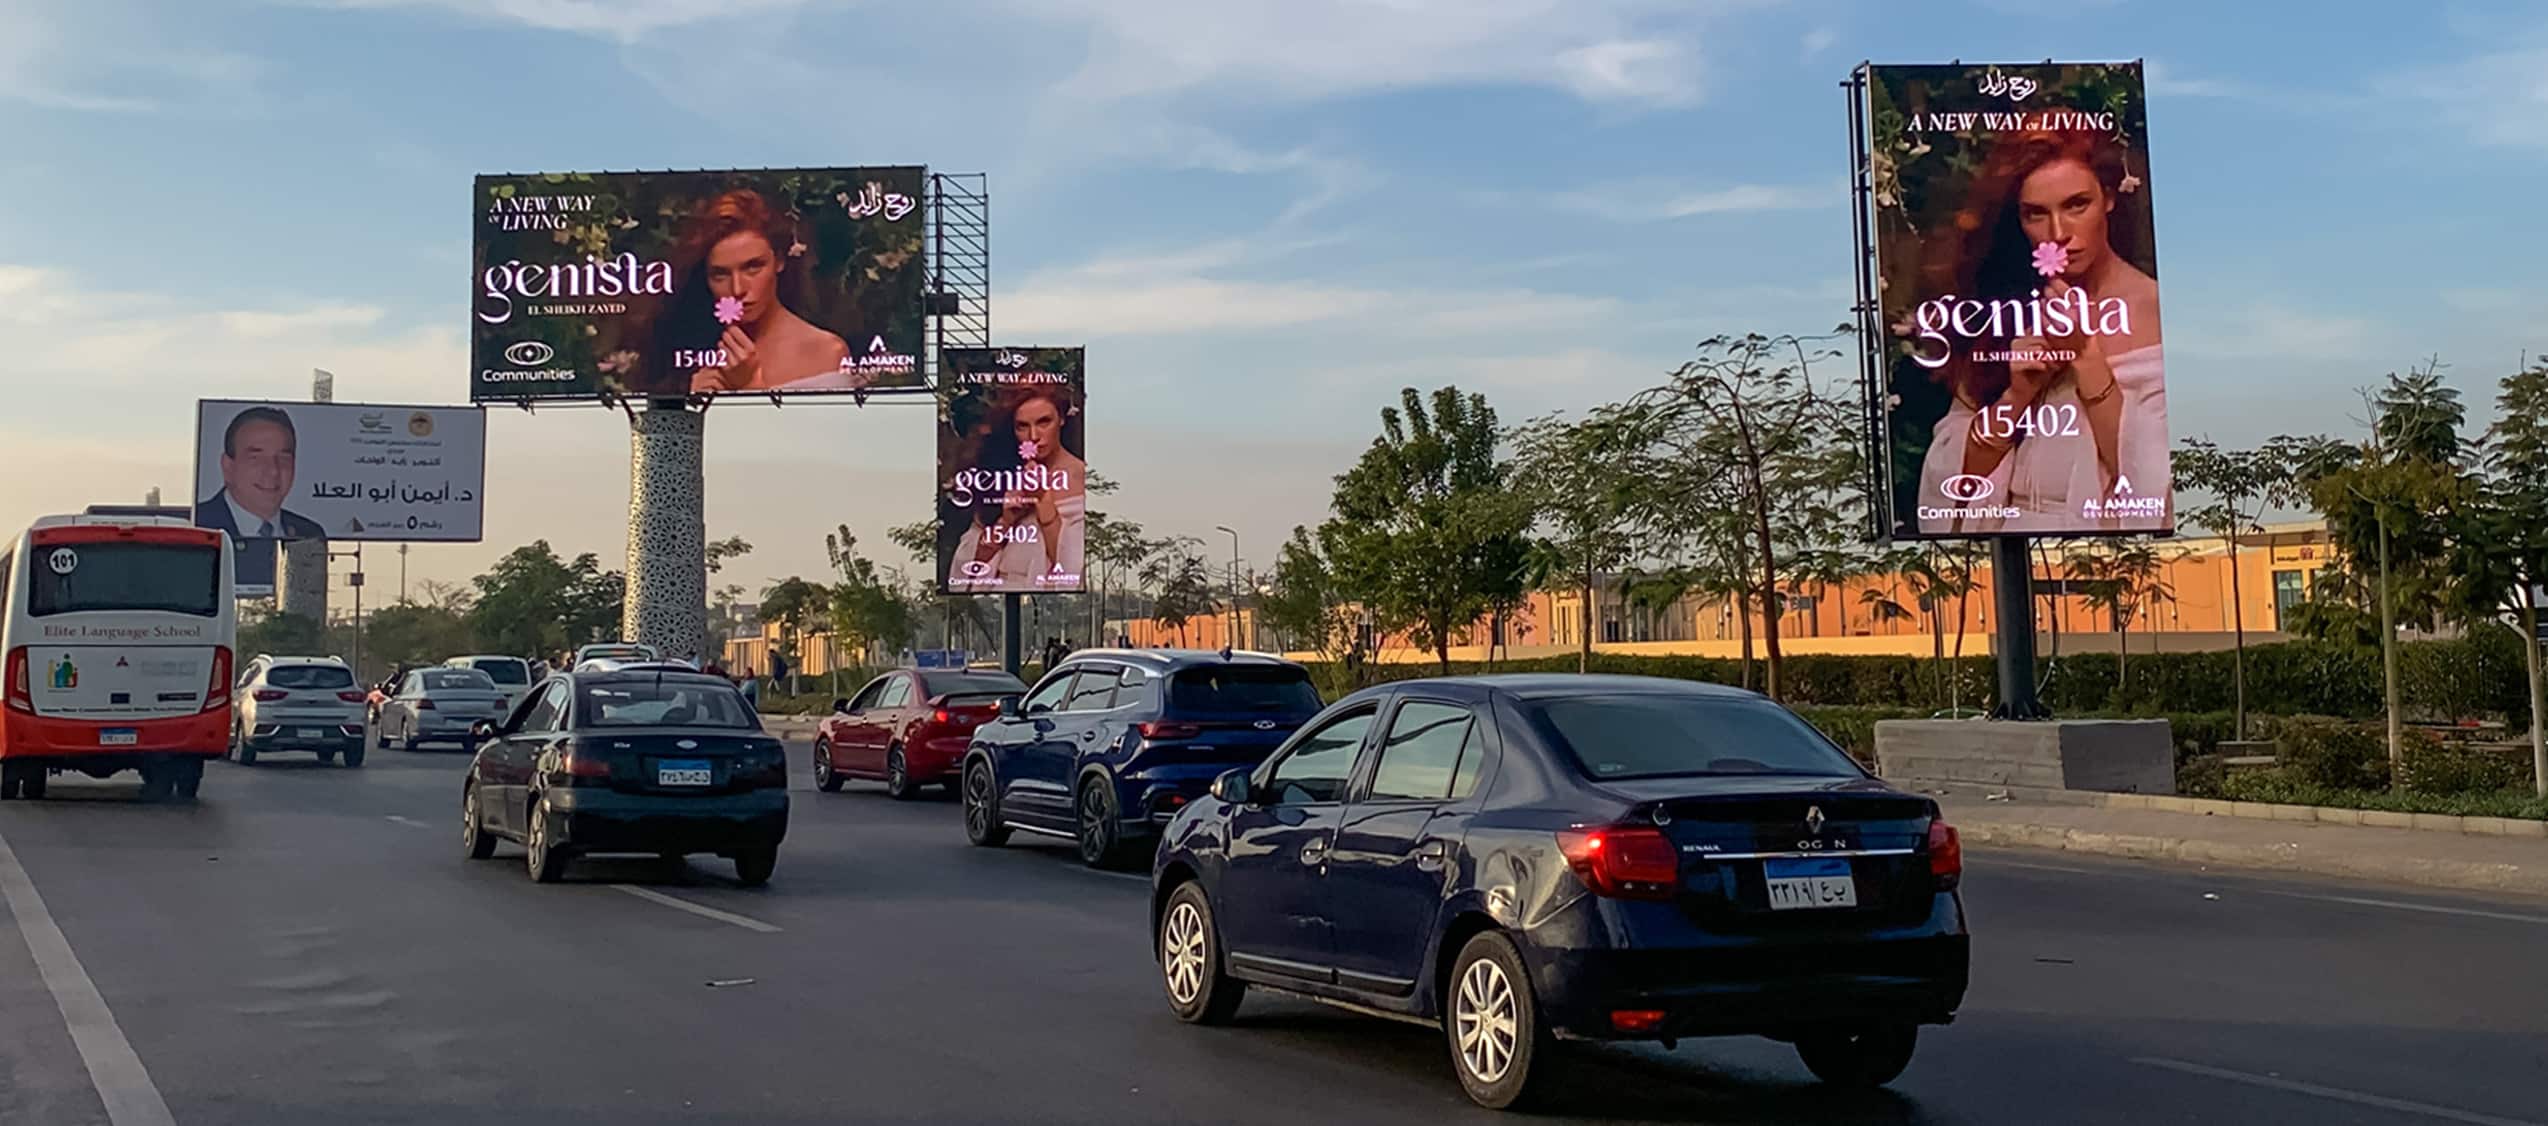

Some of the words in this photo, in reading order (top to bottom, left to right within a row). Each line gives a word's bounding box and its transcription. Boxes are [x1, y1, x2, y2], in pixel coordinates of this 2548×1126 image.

[2008, 76, 2037, 101] روح
[1907, 112, 1923, 132] A
[1928, 112, 1979, 132] NEW
[1982, 112, 2027, 132] WAY
[2040, 111, 2114, 132] LIVING
[489, 197, 503, 213] A
[507, 196, 553, 213] NEW
[556, 195, 596, 212] WAY
[884, 193, 917, 221] روح
[502, 213, 569, 231] LIVING
[478, 251, 674, 324] genista
[528, 305, 541, 316] EL
[588, 303, 627, 315] ZAYED
[1912, 285, 2132, 368] genista
[673, 349, 728, 368] 15402
[840, 355, 854, 366] AL
[859, 354, 915, 366] AMAKEN
[1973, 351, 1988, 362] EL
[1989, 351, 2033, 362] SHEIKH
[2035, 350, 2076, 362] ZAYED
[482, 368, 576, 382] Communities
[957, 373, 966, 384] A
[967, 372, 995, 384] NEW
[996, 373, 1021, 384] WAY
[1028, 372, 1069, 384] LIVING
[1979, 404, 2080, 438] 15402
[312, 481, 362, 499] العلا
[368, 480, 396, 503] أبو
[401, 481, 449, 504] أيمن
[951, 463, 1070, 507] genista
[1917, 504, 2021, 520] Communities
[2083, 498, 2101, 510] AL
[2104, 498, 2165, 510] AMAKEN
[2083, 510, 2166, 519] DEVELOPMENTS
[983, 525, 1039, 544] 15402
[52, 554, 75, 568] 101
[44, 625, 76, 637] Elite
[81, 625, 149, 640] Language
[153, 625, 202, 637] School
